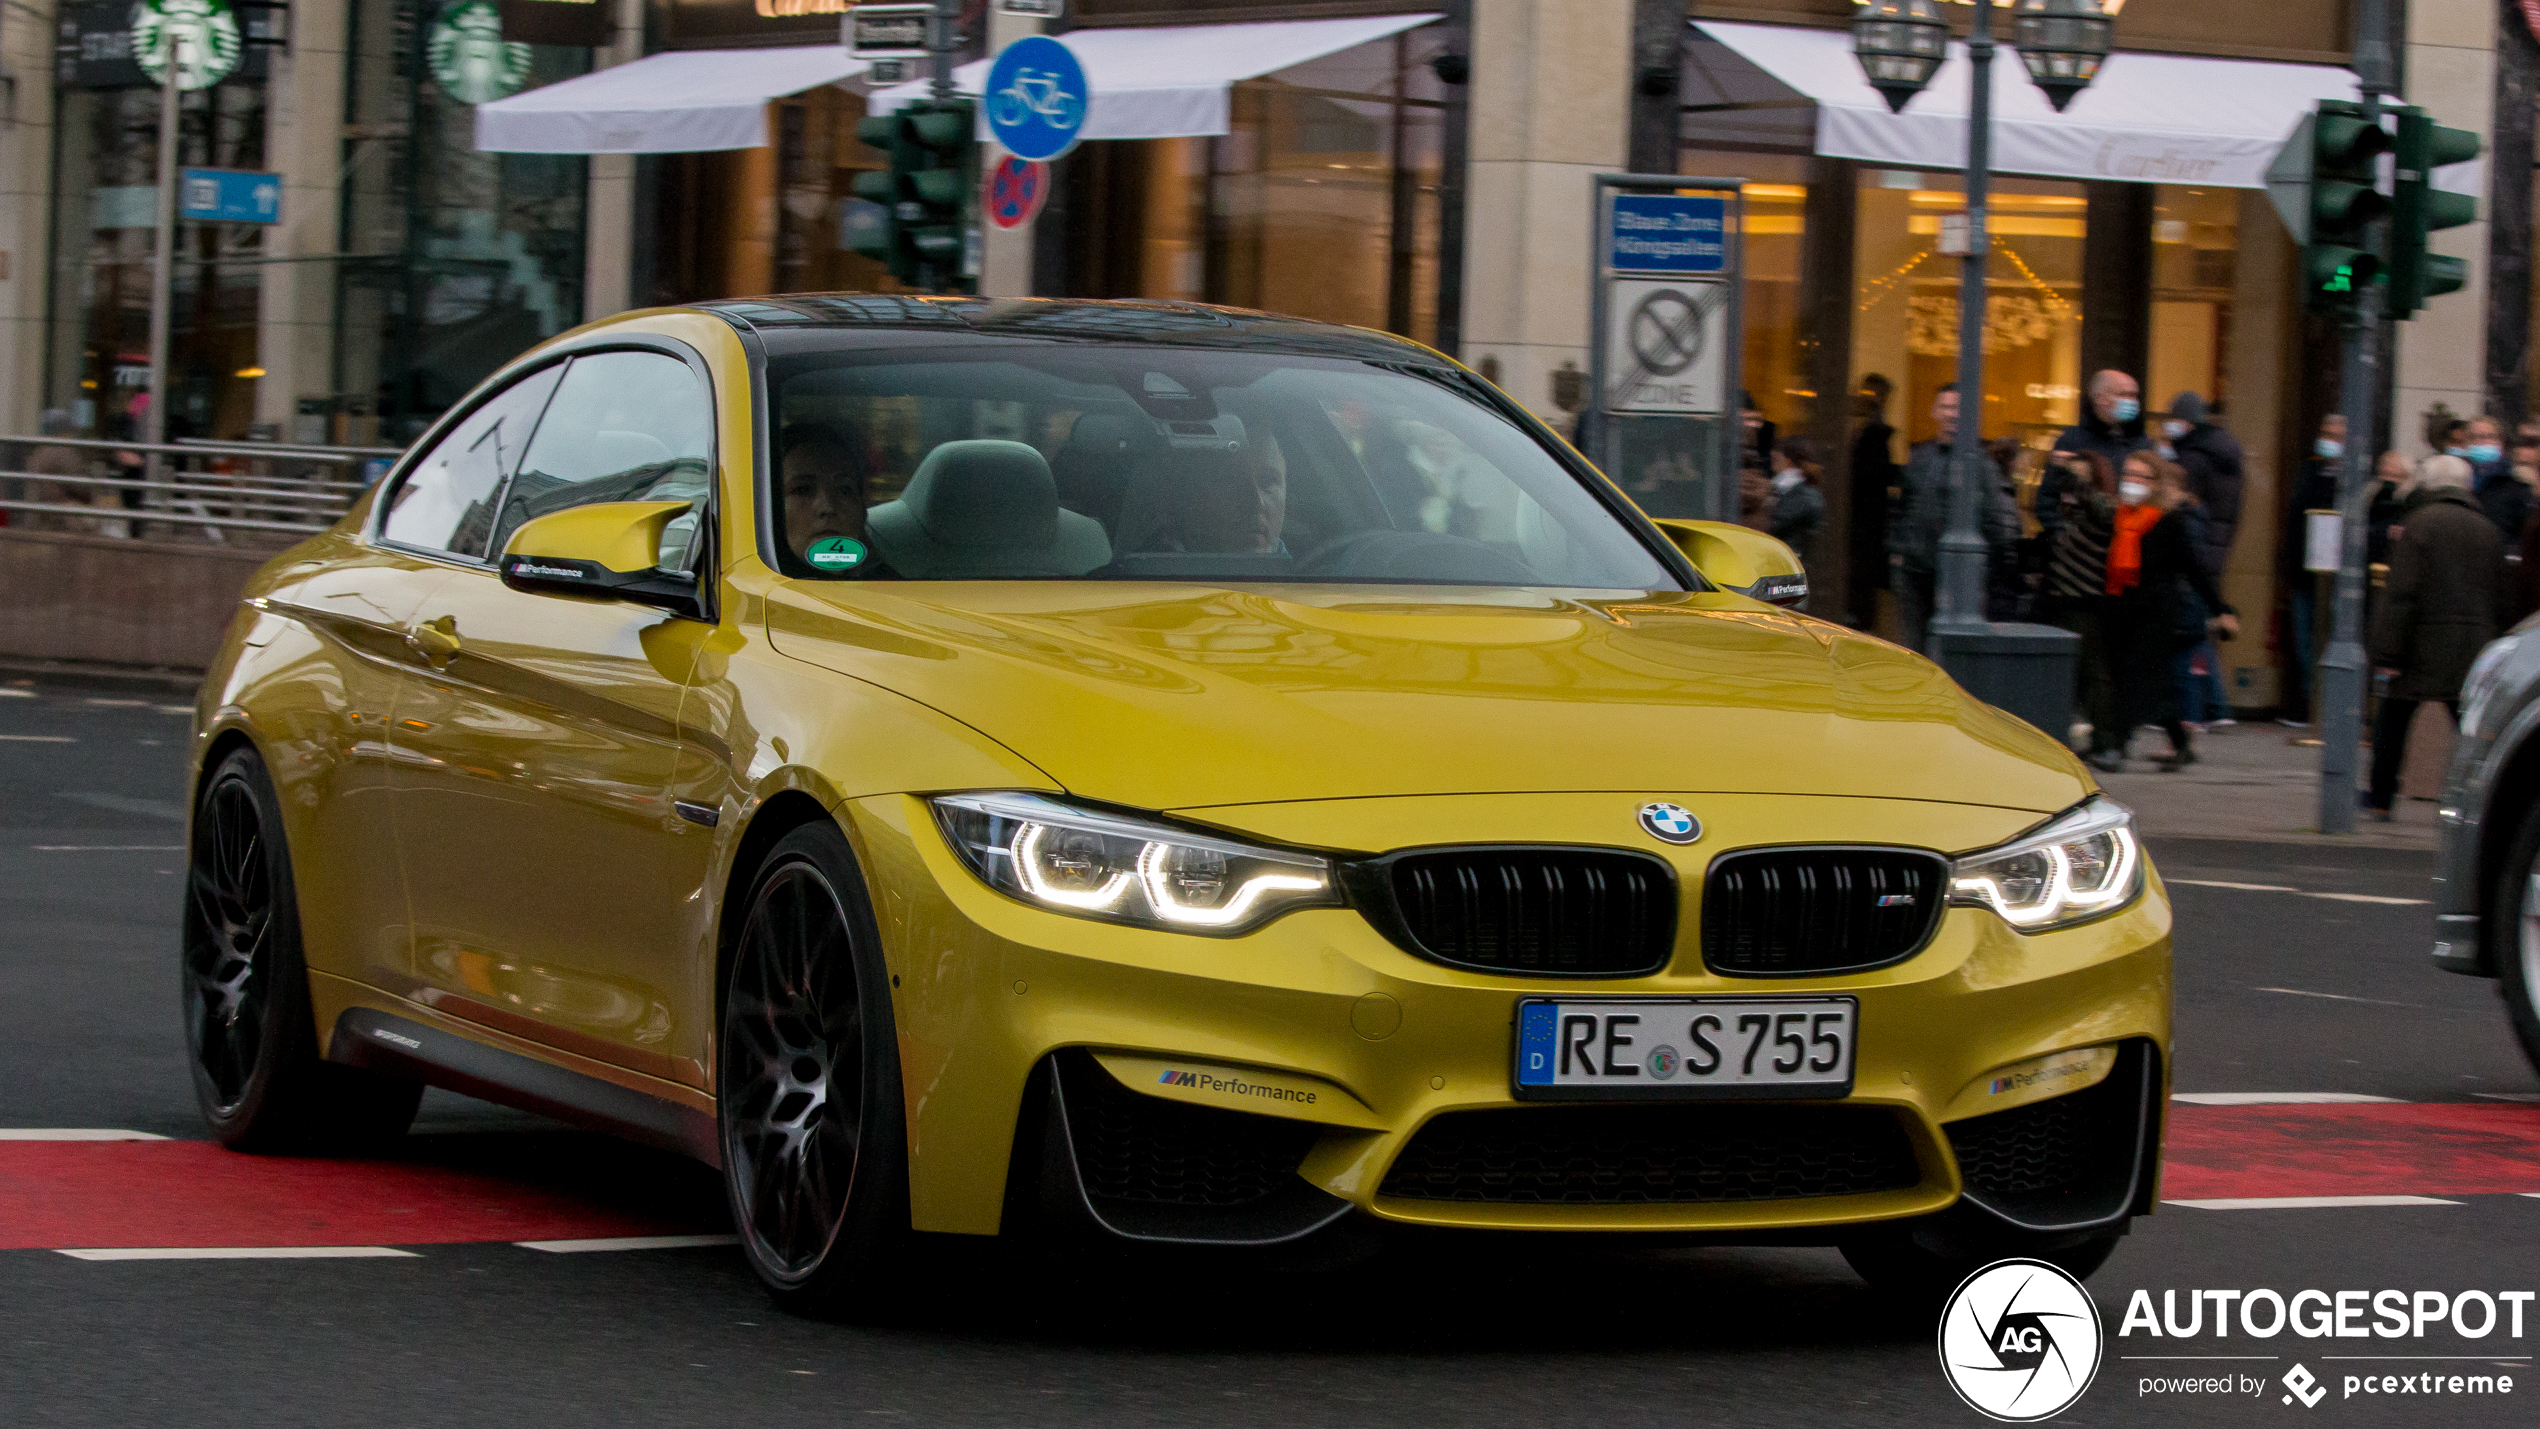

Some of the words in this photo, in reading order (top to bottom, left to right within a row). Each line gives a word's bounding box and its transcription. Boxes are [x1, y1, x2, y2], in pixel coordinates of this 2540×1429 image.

[1616, 211, 1671, 230] Blaue
[1672, 212, 1721, 231] Zone
[1634, 383, 1697, 404] ZONE
[829, 539, 844, 553] 4
[1778, 584, 1807, 594] Performa
[1560, 1014, 1640, 1076] RE
[1686, 1014, 1723, 1076] S
[1738, 1012, 1845, 1075] 755
[1530, 1052, 1544, 1070] D
[1199, 1073, 1317, 1104] Performance
